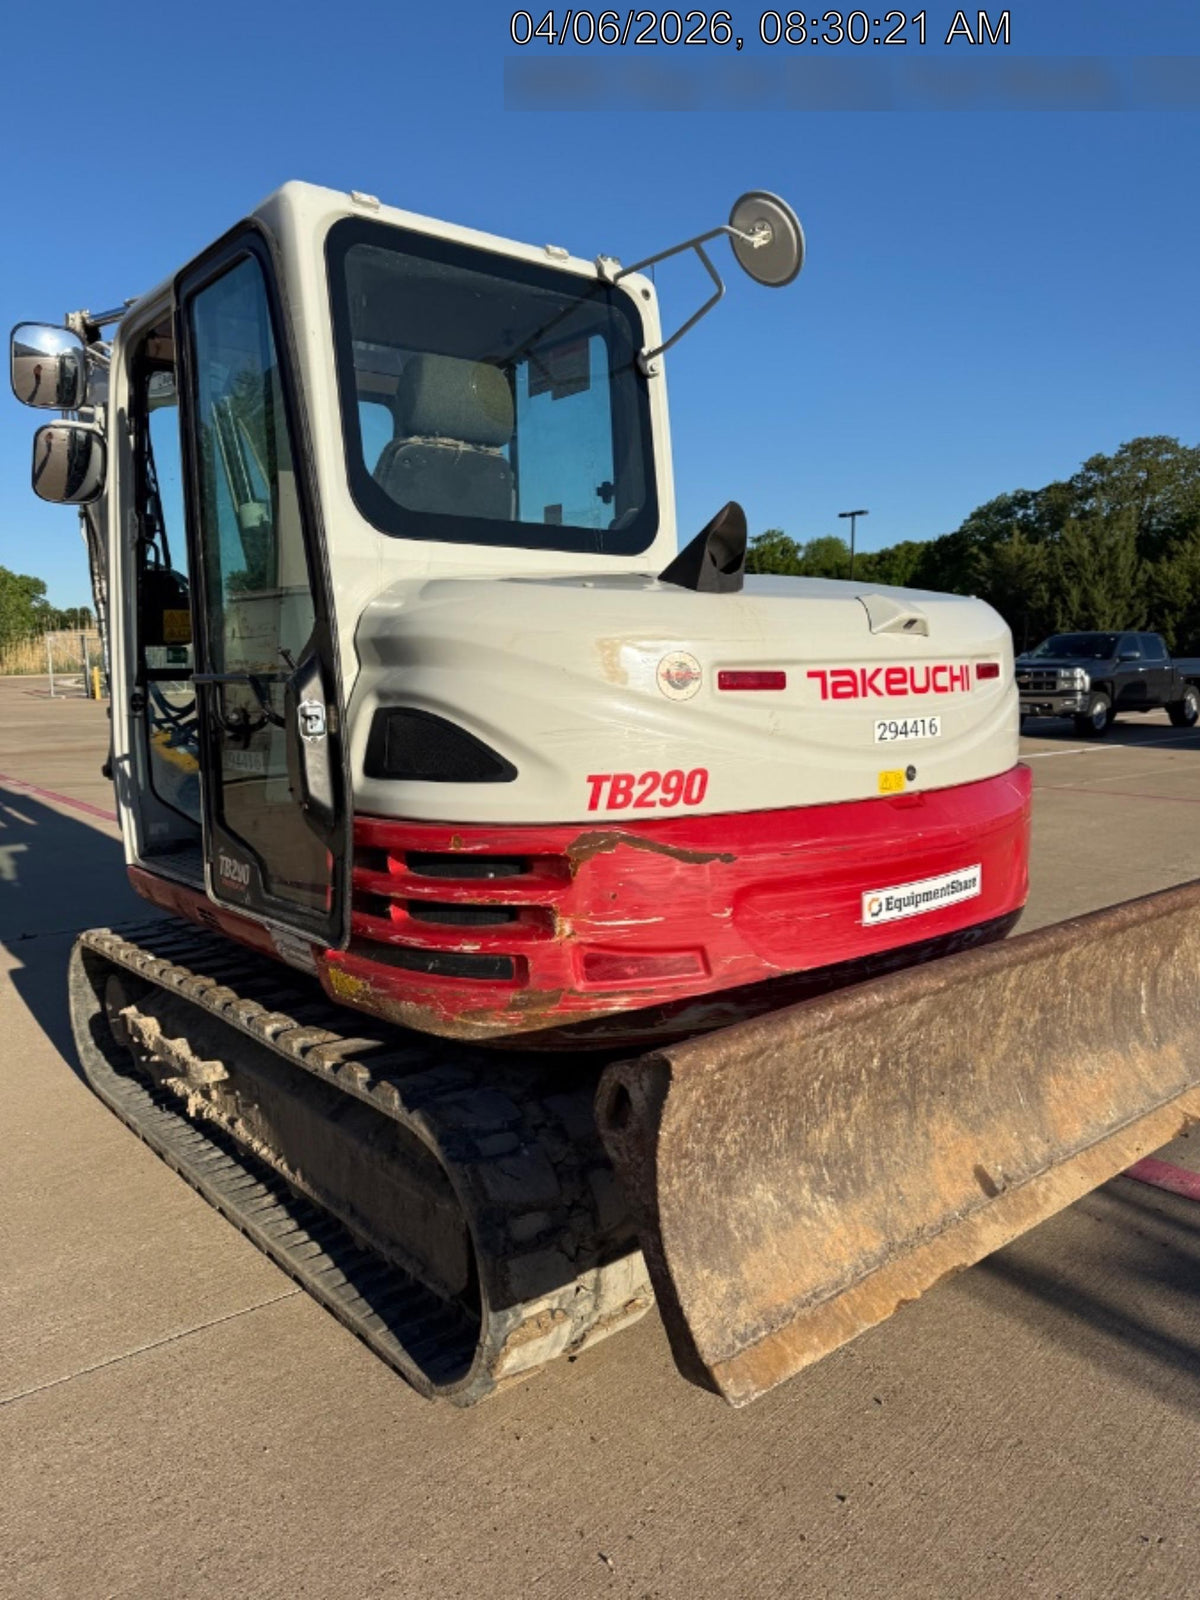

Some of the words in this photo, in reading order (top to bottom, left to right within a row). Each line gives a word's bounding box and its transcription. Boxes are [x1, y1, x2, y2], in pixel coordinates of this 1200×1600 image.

[877, 717, 938, 741] 294416
[586, 767, 709, 811] TB290
[884, 877, 977, 912] EquipmentShare
